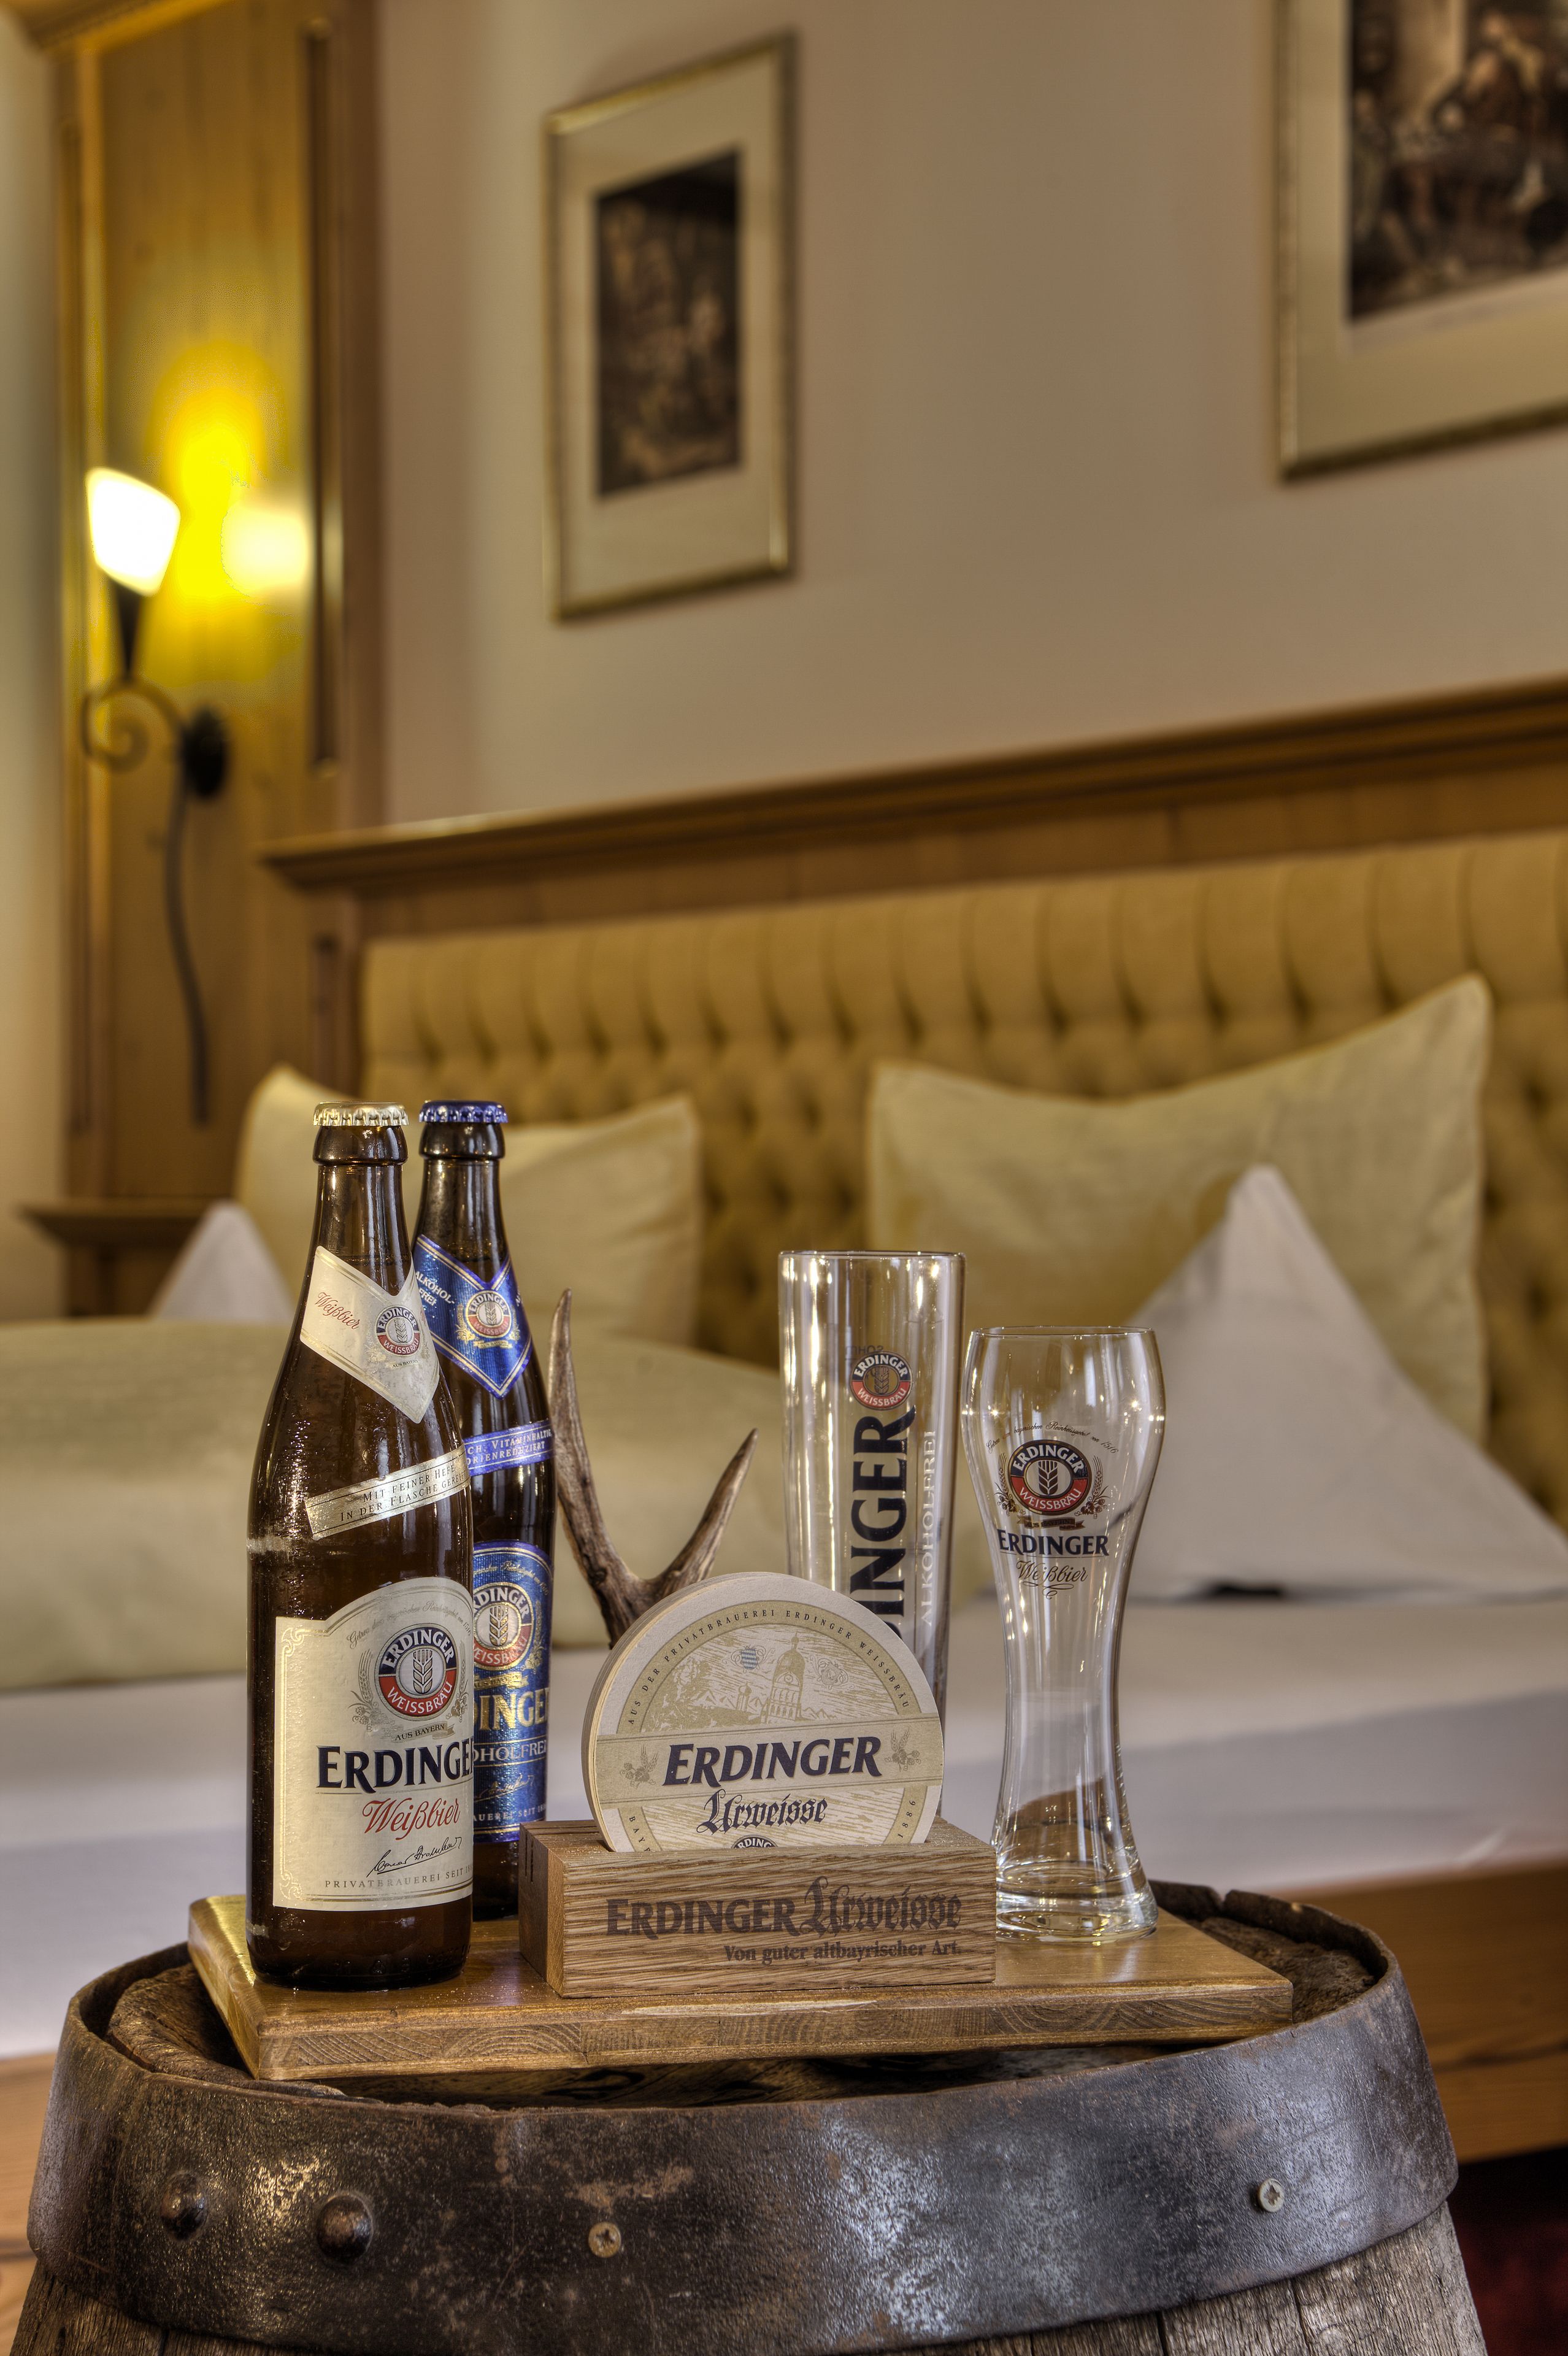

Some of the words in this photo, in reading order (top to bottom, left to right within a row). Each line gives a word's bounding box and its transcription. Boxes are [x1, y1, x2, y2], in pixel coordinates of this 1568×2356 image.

[315, 1292, 360, 1330] Weißbier
[379, 1307, 417, 1330] ERDINGER
[471, 1293, 507, 1312] ERDINGER
[854, 1355, 908, 1377] ERDINGER
[1013, 1444, 1085, 1473] ERDINGER
[1101, 1441, 1119, 1453] 1516
[363, 1489, 385, 1503] MIT
[393, 1476, 429, 1493] FEINER
[435, 1464, 455, 1479] HEFE
[1020, 1487, 1082, 1510] WEISSBRÄU
[340, 1512, 353, 1522] IN
[360, 1502, 383, 1516] DER
[391, 1484, 437, 1506] FLASCHE
[850, 1406, 917, 1640] INGER
[921, 1431, 936, 1626] ALKOHOLFREI
[997, 1528, 1109, 1556] ERDINGER
[1017, 1560, 1088, 1585] Weißbier
[383, 1629, 455, 1668] ERDINGER
[628, 1700, 641, 1725] AUS
[642, 1668, 660, 1692] DER
[664, 1609, 774, 1662] PRIVATBRAUEREI
[786, 1610, 851, 1639] ERDINGER
[859, 1641, 909, 1707] WEISSBRÄU
[388, 1680, 452, 1714] WEISSBRÄU
[395, 1731, 413, 1741] AUS
[415, 1723, 445, 1736] BAYERN
[662, 1736, 882, 1788] ERDINGER
[362, 1798, 461, 1841] Weißbier
[696, 1788, 828, 1835] Urweisse
[897, 1800, 916, 1839] 1886
[325, 1874, 440, 1888] PRIVATBRAUEREI
[446, 1868, 463, 1879] SEIT
[606, 1898, 801, 1940] ERDINGER
[799, 1876, 962, 1938] Urweisse
[724, 1946, 756, 1962] Von
[762, 1944, 809, 1966] guter
[813, 1939, 926, 1963] altbayrischer
[932, 1939, 962, 1955] Art.
